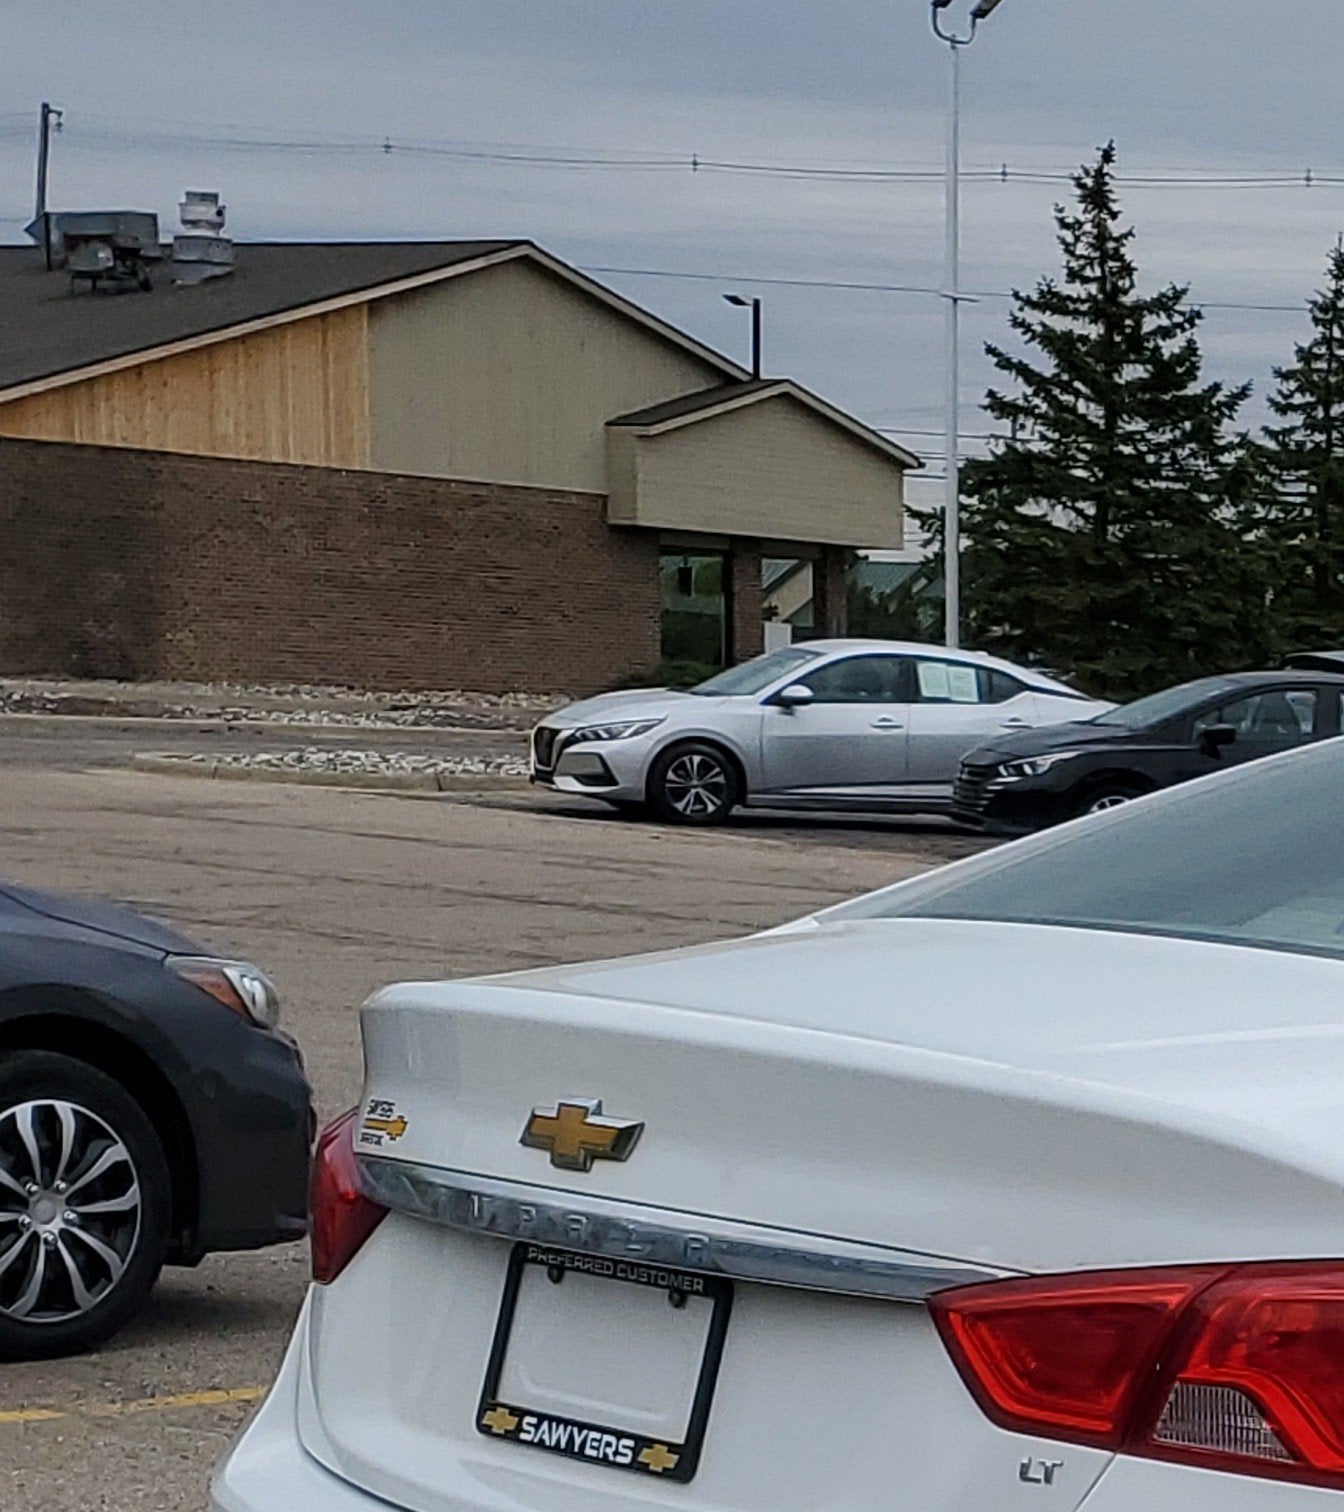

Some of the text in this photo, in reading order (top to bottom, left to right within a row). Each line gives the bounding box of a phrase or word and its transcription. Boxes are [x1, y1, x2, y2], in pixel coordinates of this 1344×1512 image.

[527, 1247, 704, 1293] PREFERRED CUSTOMER
[518, 1416, 635, 1464] SAWYERS
[1018, 1456, 1065, 1485] LT
